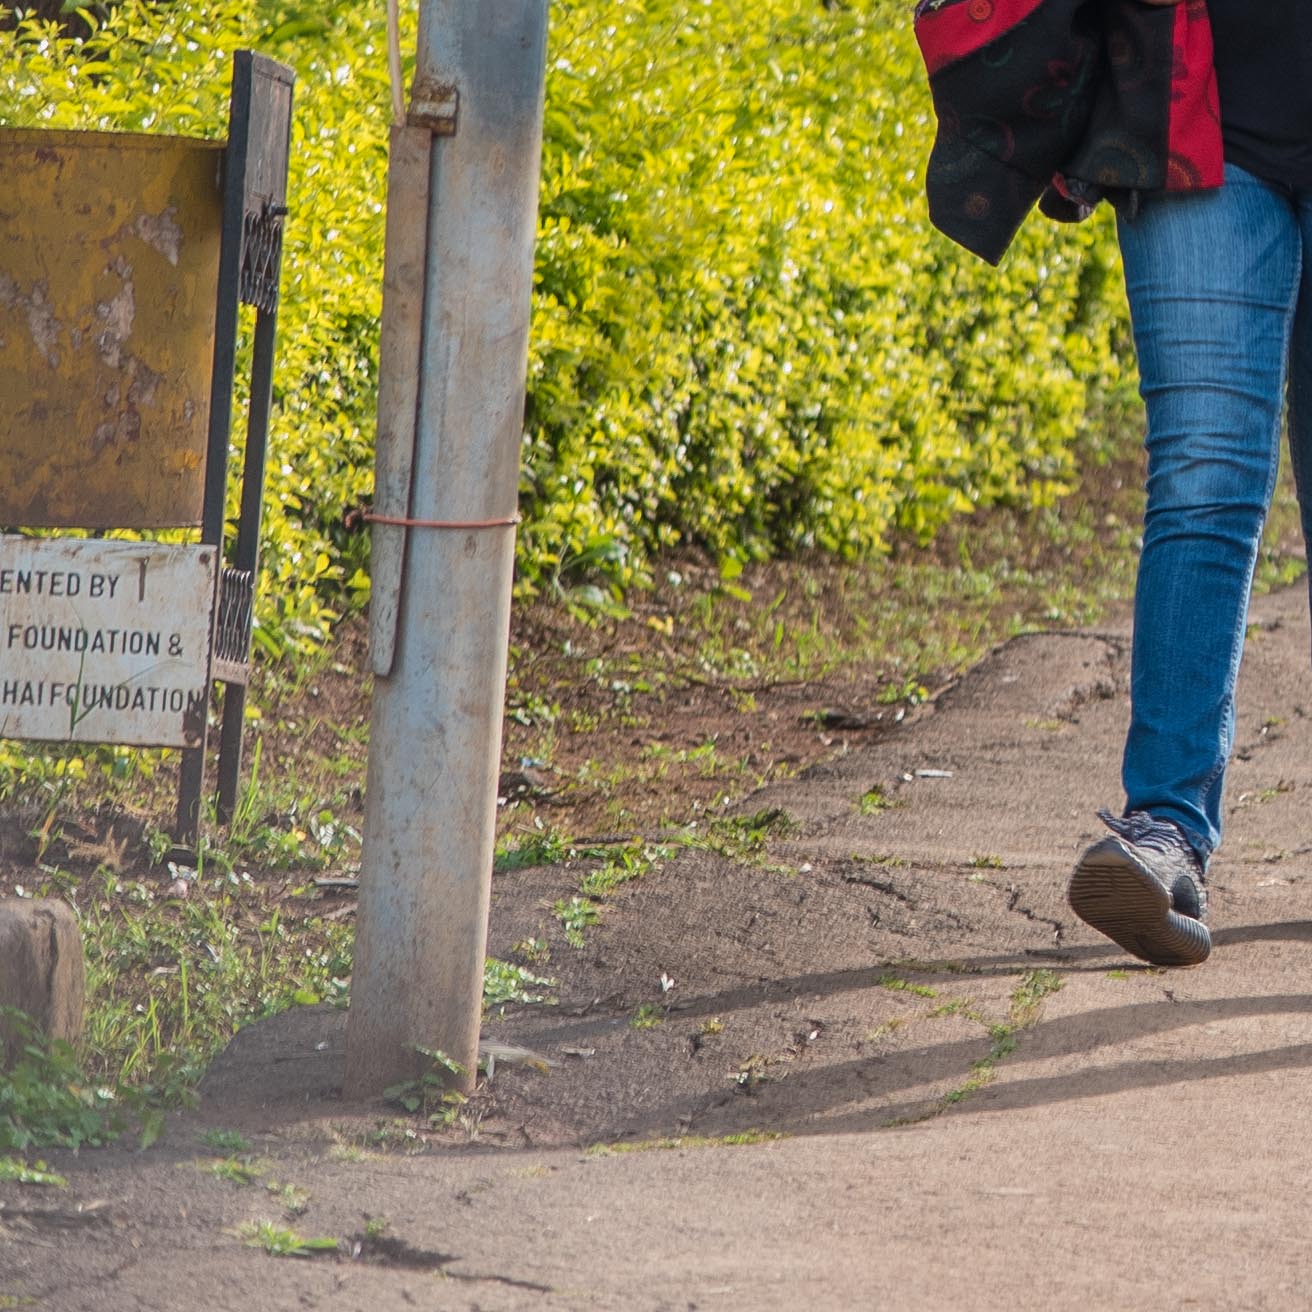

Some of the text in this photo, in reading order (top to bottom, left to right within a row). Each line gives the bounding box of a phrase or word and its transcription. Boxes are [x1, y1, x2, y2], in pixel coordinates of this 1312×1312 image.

[0, 569, 120, 598] ENTED BY
[7, 625, 183, 658] FOUNDATION &
[50, 681, 202, 713] FOUNDATION
